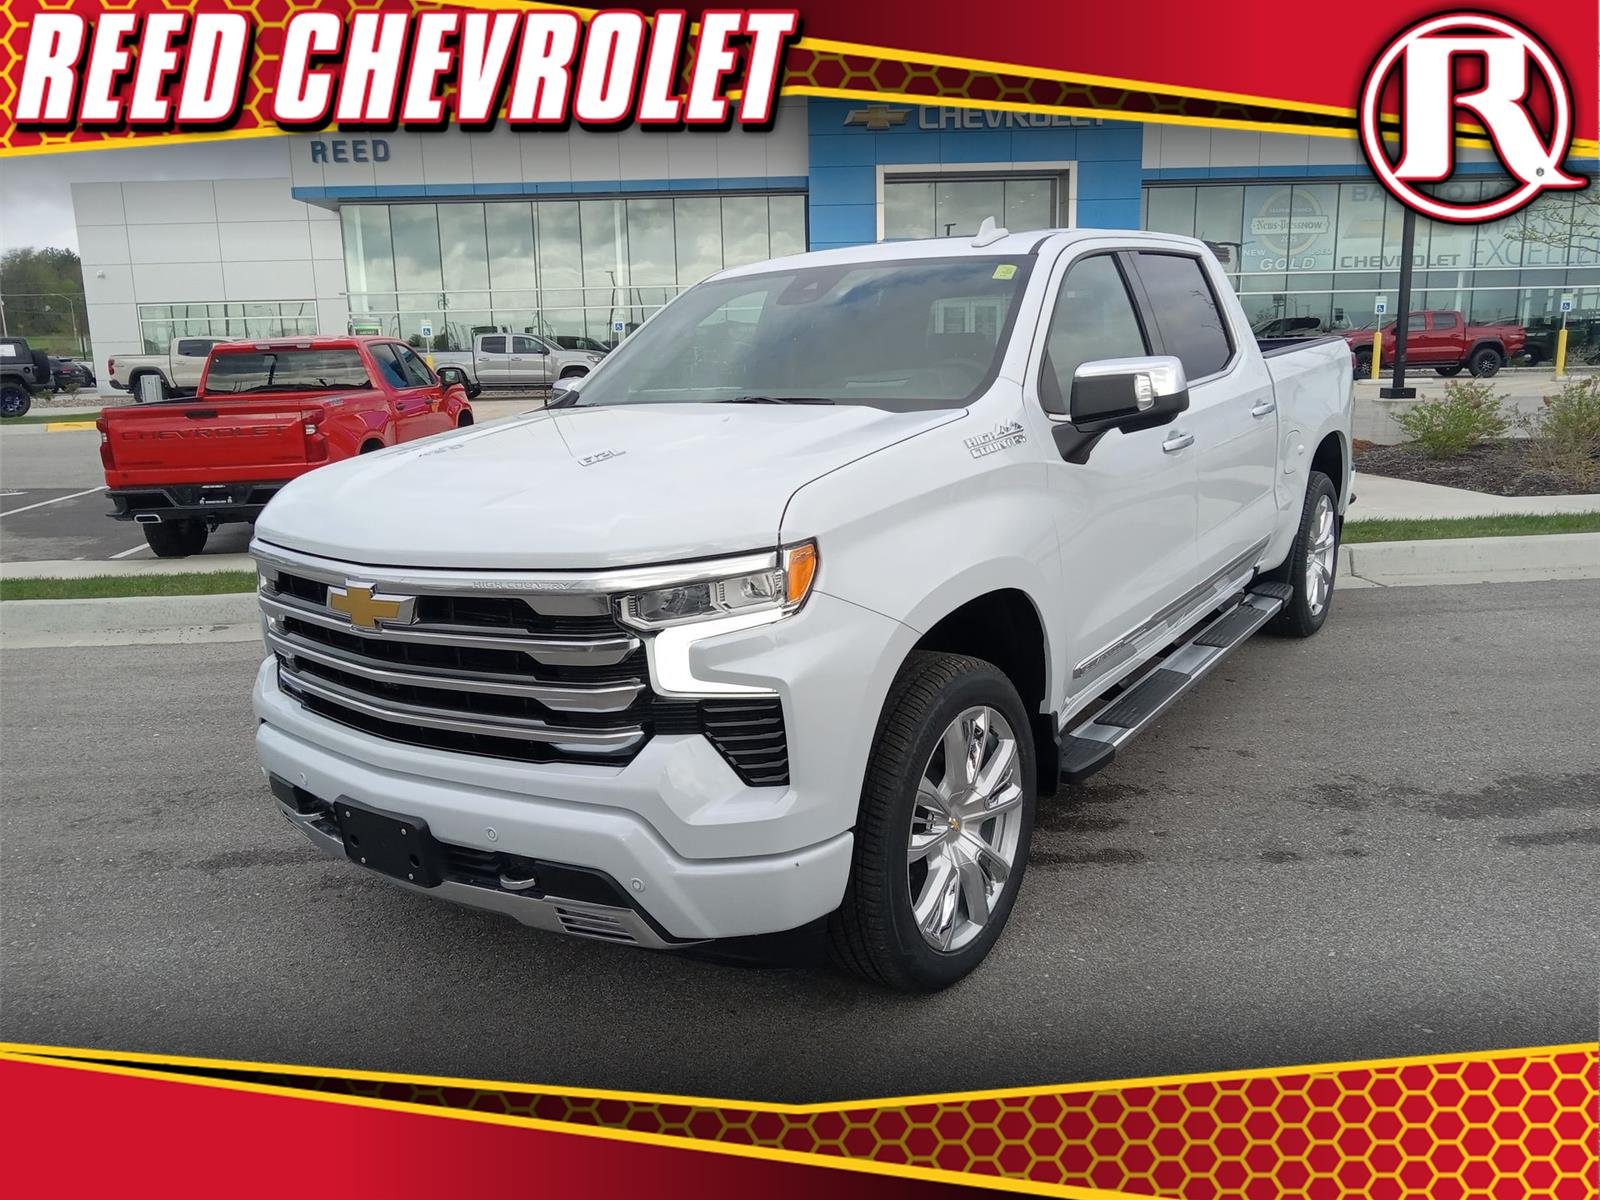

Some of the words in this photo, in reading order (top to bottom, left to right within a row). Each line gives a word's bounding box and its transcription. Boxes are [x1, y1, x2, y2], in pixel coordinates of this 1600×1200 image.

[918, 104, 1105, 129] CHEVROL
[310, 139, 391, 164] REED
[1243, 248, 1267, 257] NEW
[1469, 238, 1599, 267] EXCELLE
[1260, 257, 1316, 271] GOLD
[1340, 253, 1461, 269] CHEVOLET
[120, 426, 289, 441] CHEVROLET
